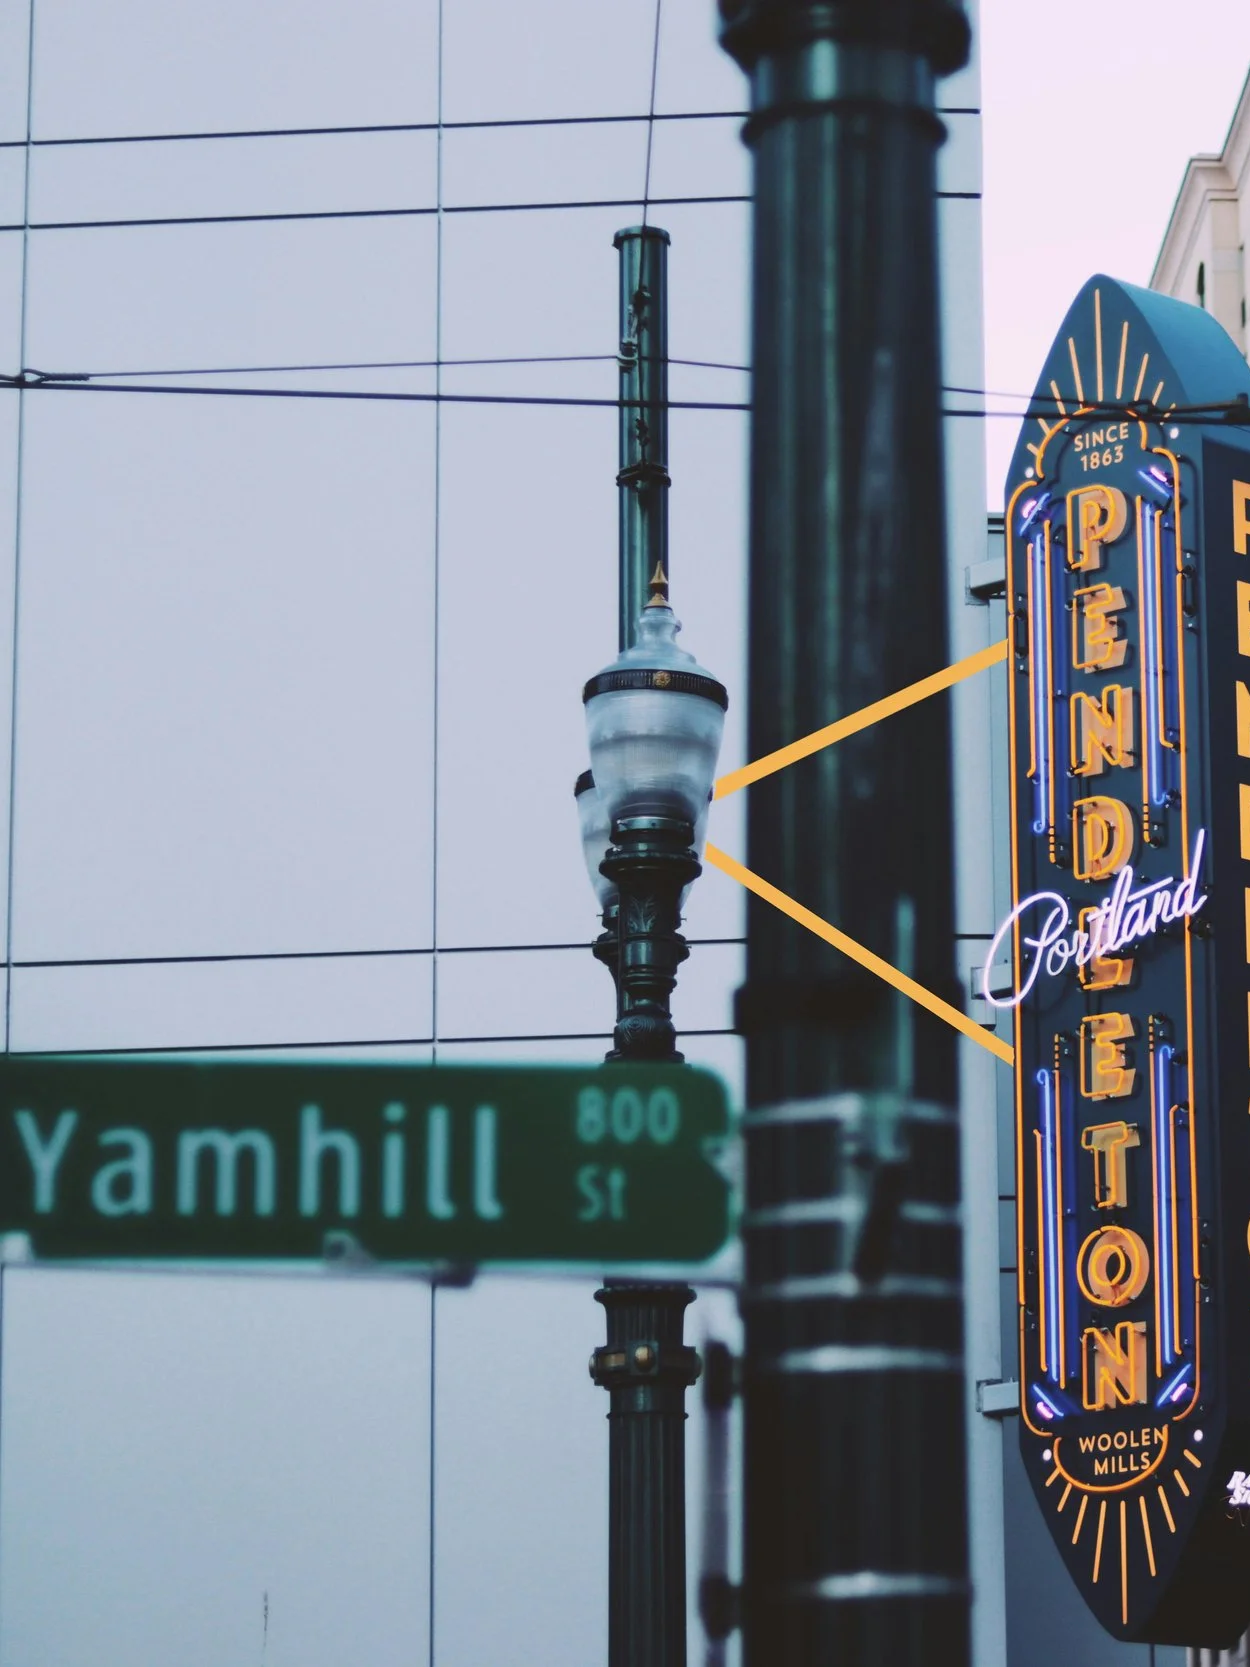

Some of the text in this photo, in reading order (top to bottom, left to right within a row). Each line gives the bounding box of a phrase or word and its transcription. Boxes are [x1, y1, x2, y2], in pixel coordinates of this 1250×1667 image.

[1074, 422, 1129, 452] SINCE
[1080, 446, 1124, 471] 1863
[983, 828, 1208, 1008] Portland
[576, 1086, 679, 1144] 800
[14, 1104, 502, 1217] Yamhill
[577, 1166, 627, 1221] St
[1078, 1427, 1166, 1454] WOOLEN
[1093, 1451, 1151, 1476] MILLS
